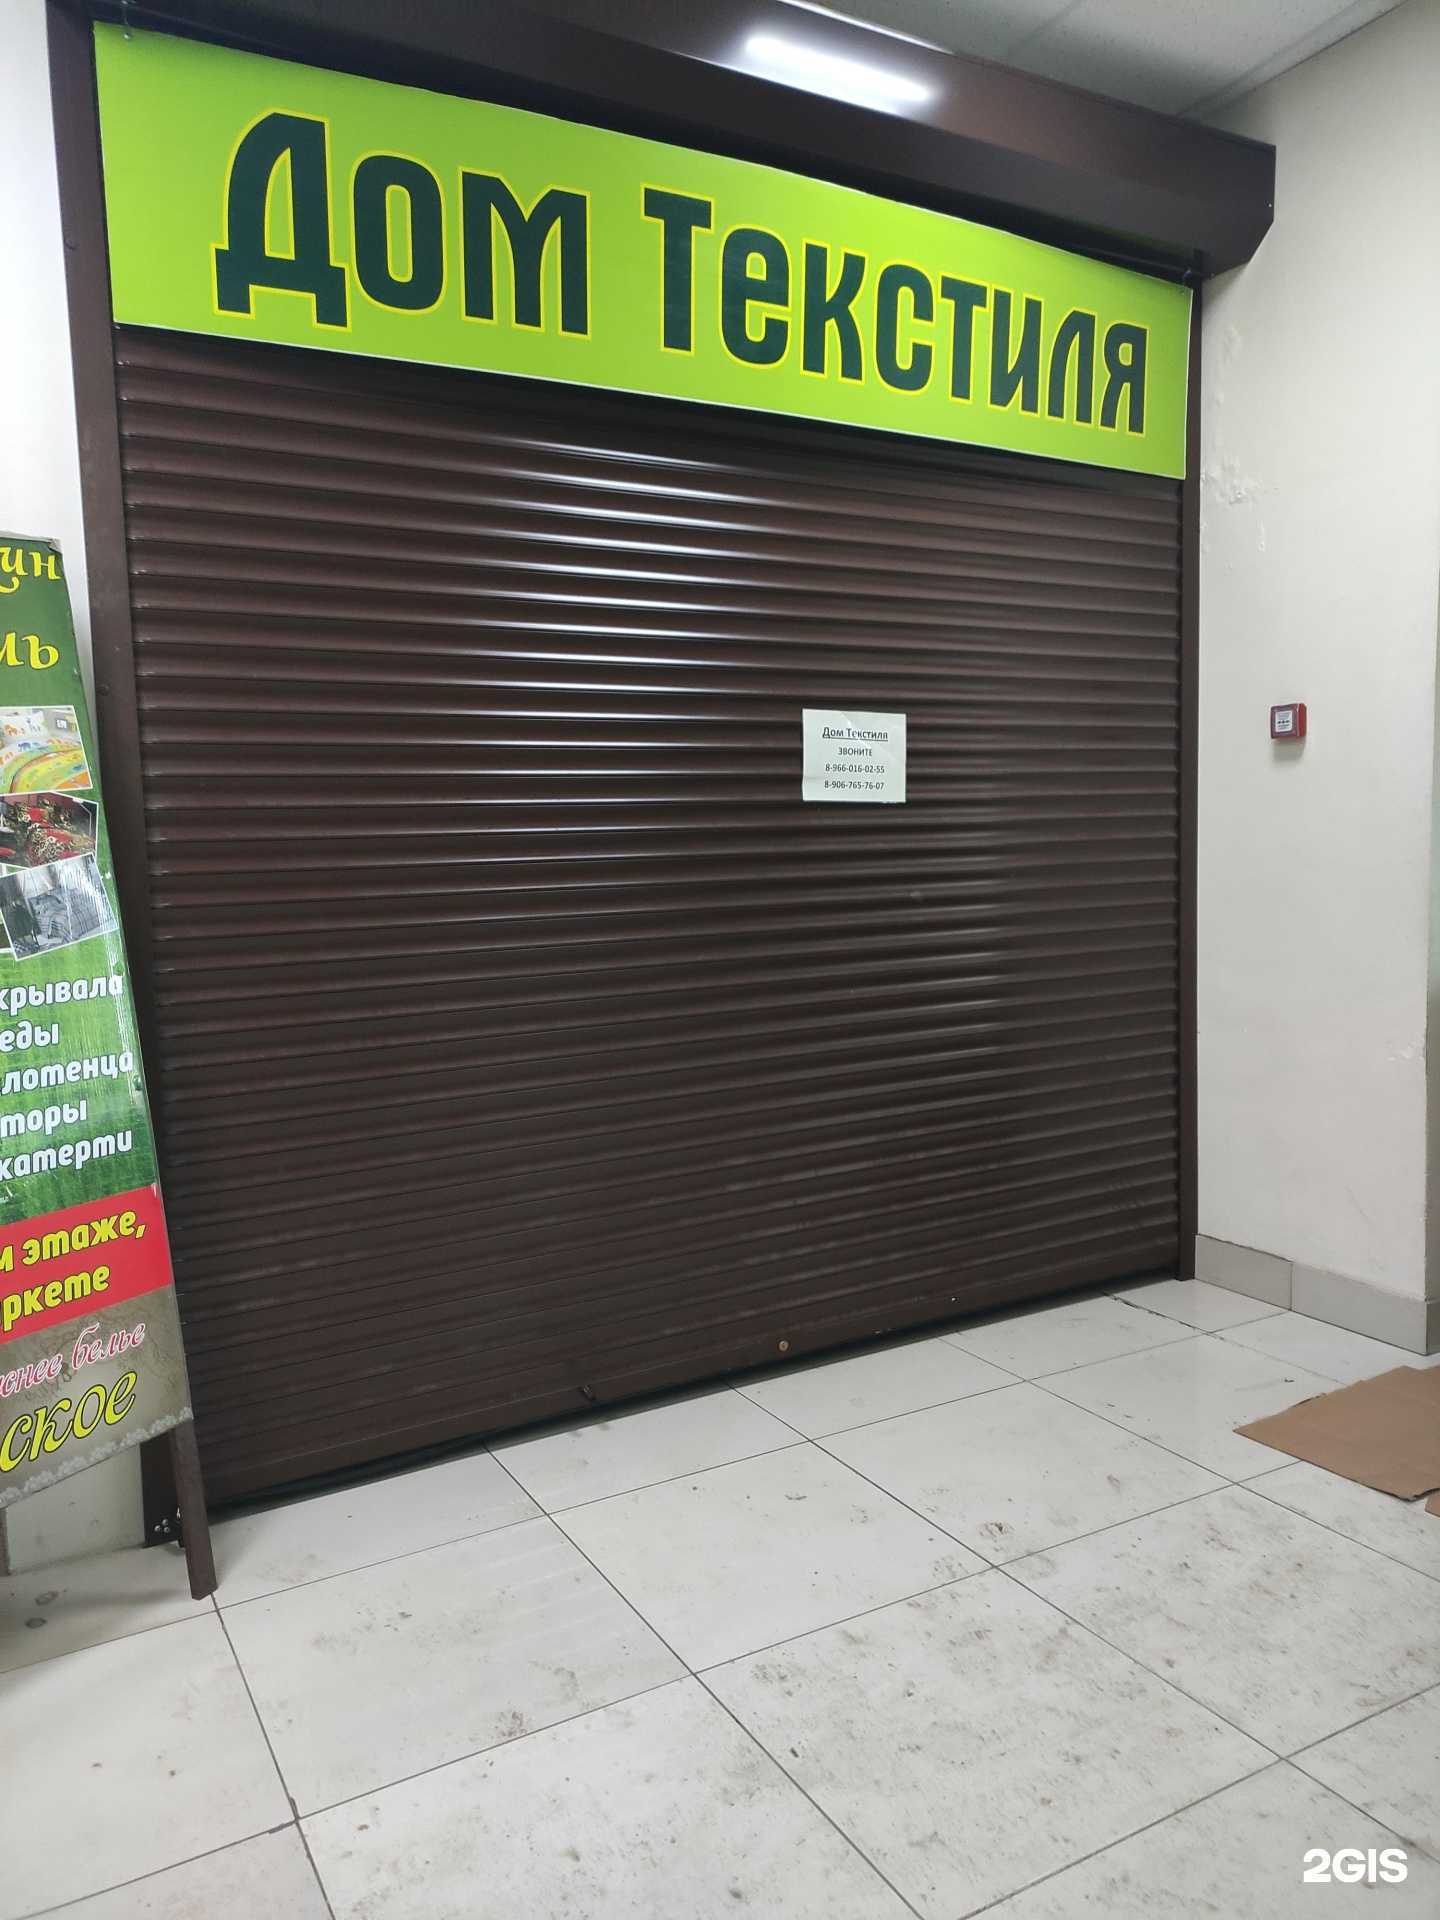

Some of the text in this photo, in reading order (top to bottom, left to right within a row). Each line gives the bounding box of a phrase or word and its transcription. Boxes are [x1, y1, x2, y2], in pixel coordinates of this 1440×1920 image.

[213, 110, 1148, 435] Дом Текстиля
[0, 546, 62, 593] ин
[822, 727, 888, 740] Дом Текстиля
[838, 747, 873, 756] ЗВОНИТЕ
[824, 780, 884, 790] 8-906-765-76-07
[825, 764, 885, 773] 8-966-016-02-55
[0, 975, 123, 1016] крывала
[0, 1021, 59, 1052] еды
[1, 1052, 133, 1094] лотенца
[0, 1100, 87, 1138] торы
[0, 1131, 132, 1179] катерти
[22, 1210, 146, 1265] этаже,
[2, 1265, 110, 1332] ркете
[72, 1322, 145, 1369] белье
[0, 1371, 137, 1472] ское
